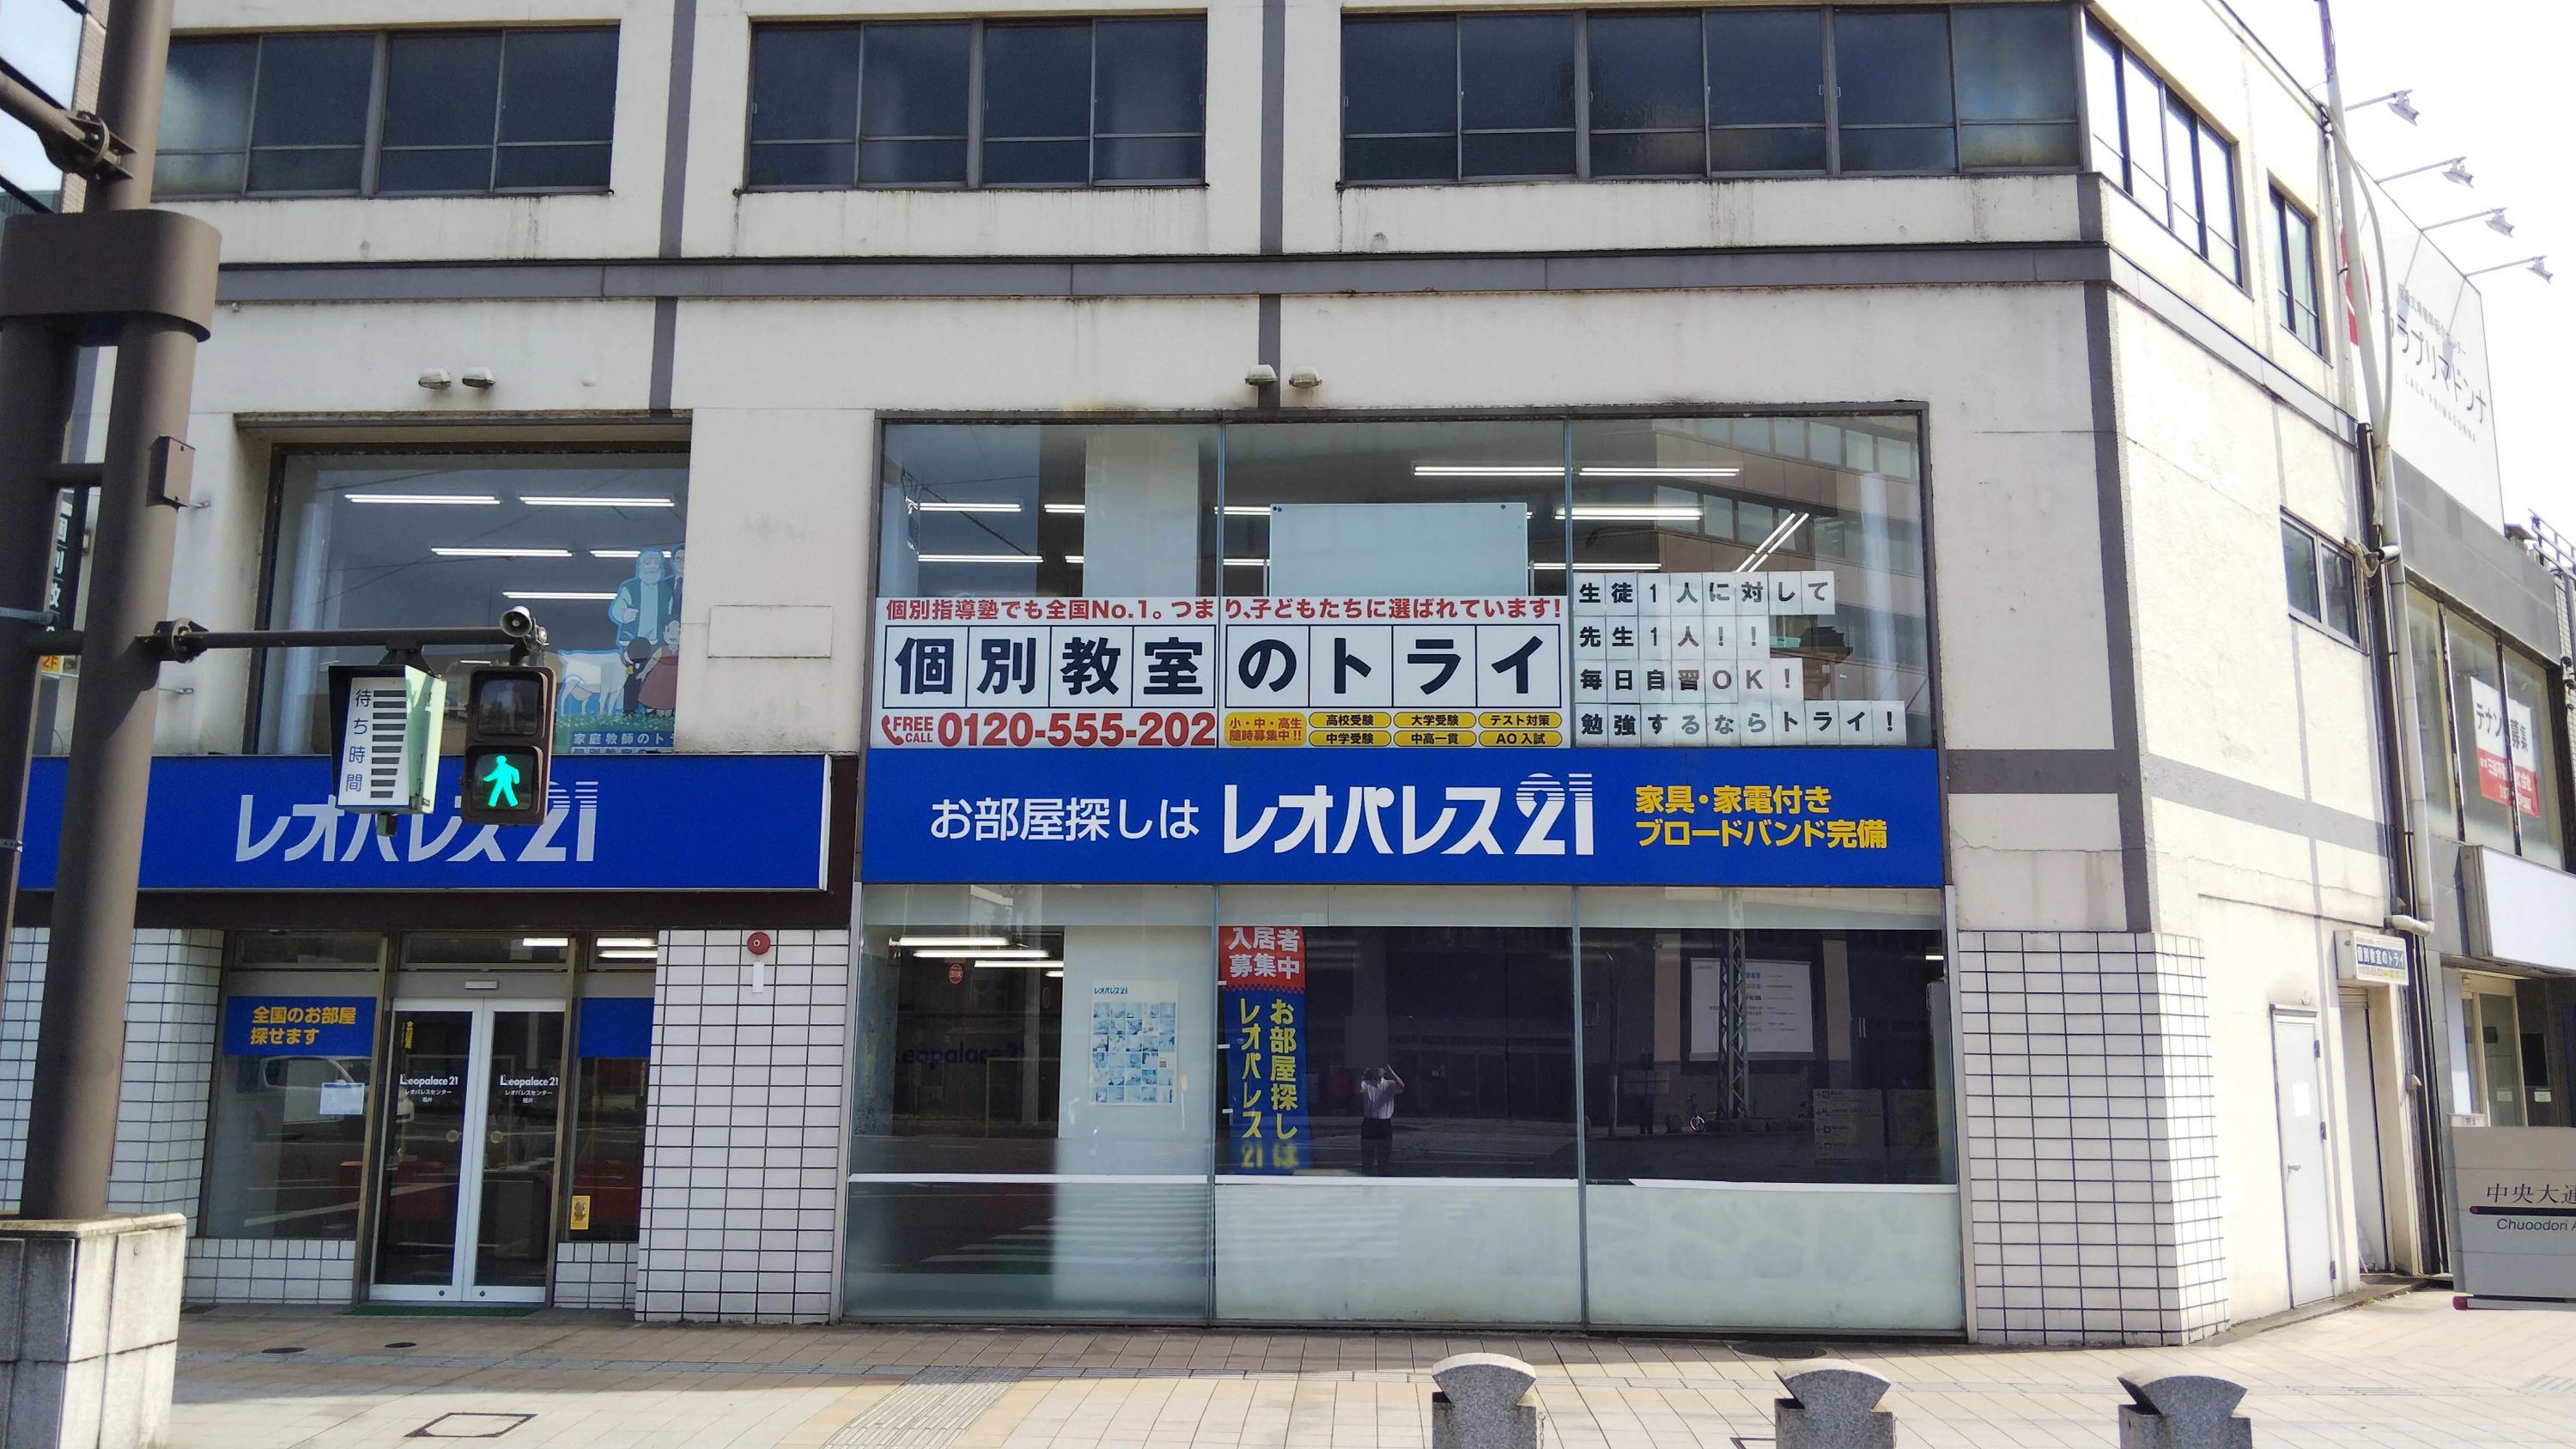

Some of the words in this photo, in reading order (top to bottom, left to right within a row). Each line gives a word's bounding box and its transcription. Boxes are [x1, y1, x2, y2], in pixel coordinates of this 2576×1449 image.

[2391, 314, 2487, 424] ラプリマドンナ
[1579, 573, 1829, 603] 生徒1人に対して
[894, 636, 1544, 695] 個別教室のトライ
[1580, 668, 1790, 692] 毎日自習OK!
[893, 716, 933, 731] FREE
[937, 712, 1216, 748] 0120-555-202
[1326, 714, 1374, 726] 高校受験
[1411, 714, 1459, 726] 大学受験
[1490, 714, 1551, 726] テスト対策
[1581, 711, 1893, 736] 勉強するならトライ!
[2476, 702, 2528, 753] テナン募集
[345, 688, 372, 792] 待ち時間
[574, 732, 674, 745] 家庭教師のト
[905, 732, 933, 743] CALL
[1326, 733, 1374, 744] 中学受験
[1411, 733, 1459, 745] 中高一貫
[1635, 785, 1832, 815] 家具・家電付き
[930, 797, 1200, 841] お部屋探しは
[1223, 773, 1595, 856] レオパレス21
[1636, 819, 1888, 849] ブロードバンド完備
[1228, 926, 1300, 952] 入居者
[1229, 953, 1300, 979] 募集中
[252, 1006, 357, 1025] 全国のお部屋
[249, 1028, 319, 1046] 探せます
[1239, 997, 1263, 1169] レオパレス21
[1269, 998, 1299, 1169] お部屋探しは
[2496, 1218, 2567, 1231] Chuoodori
